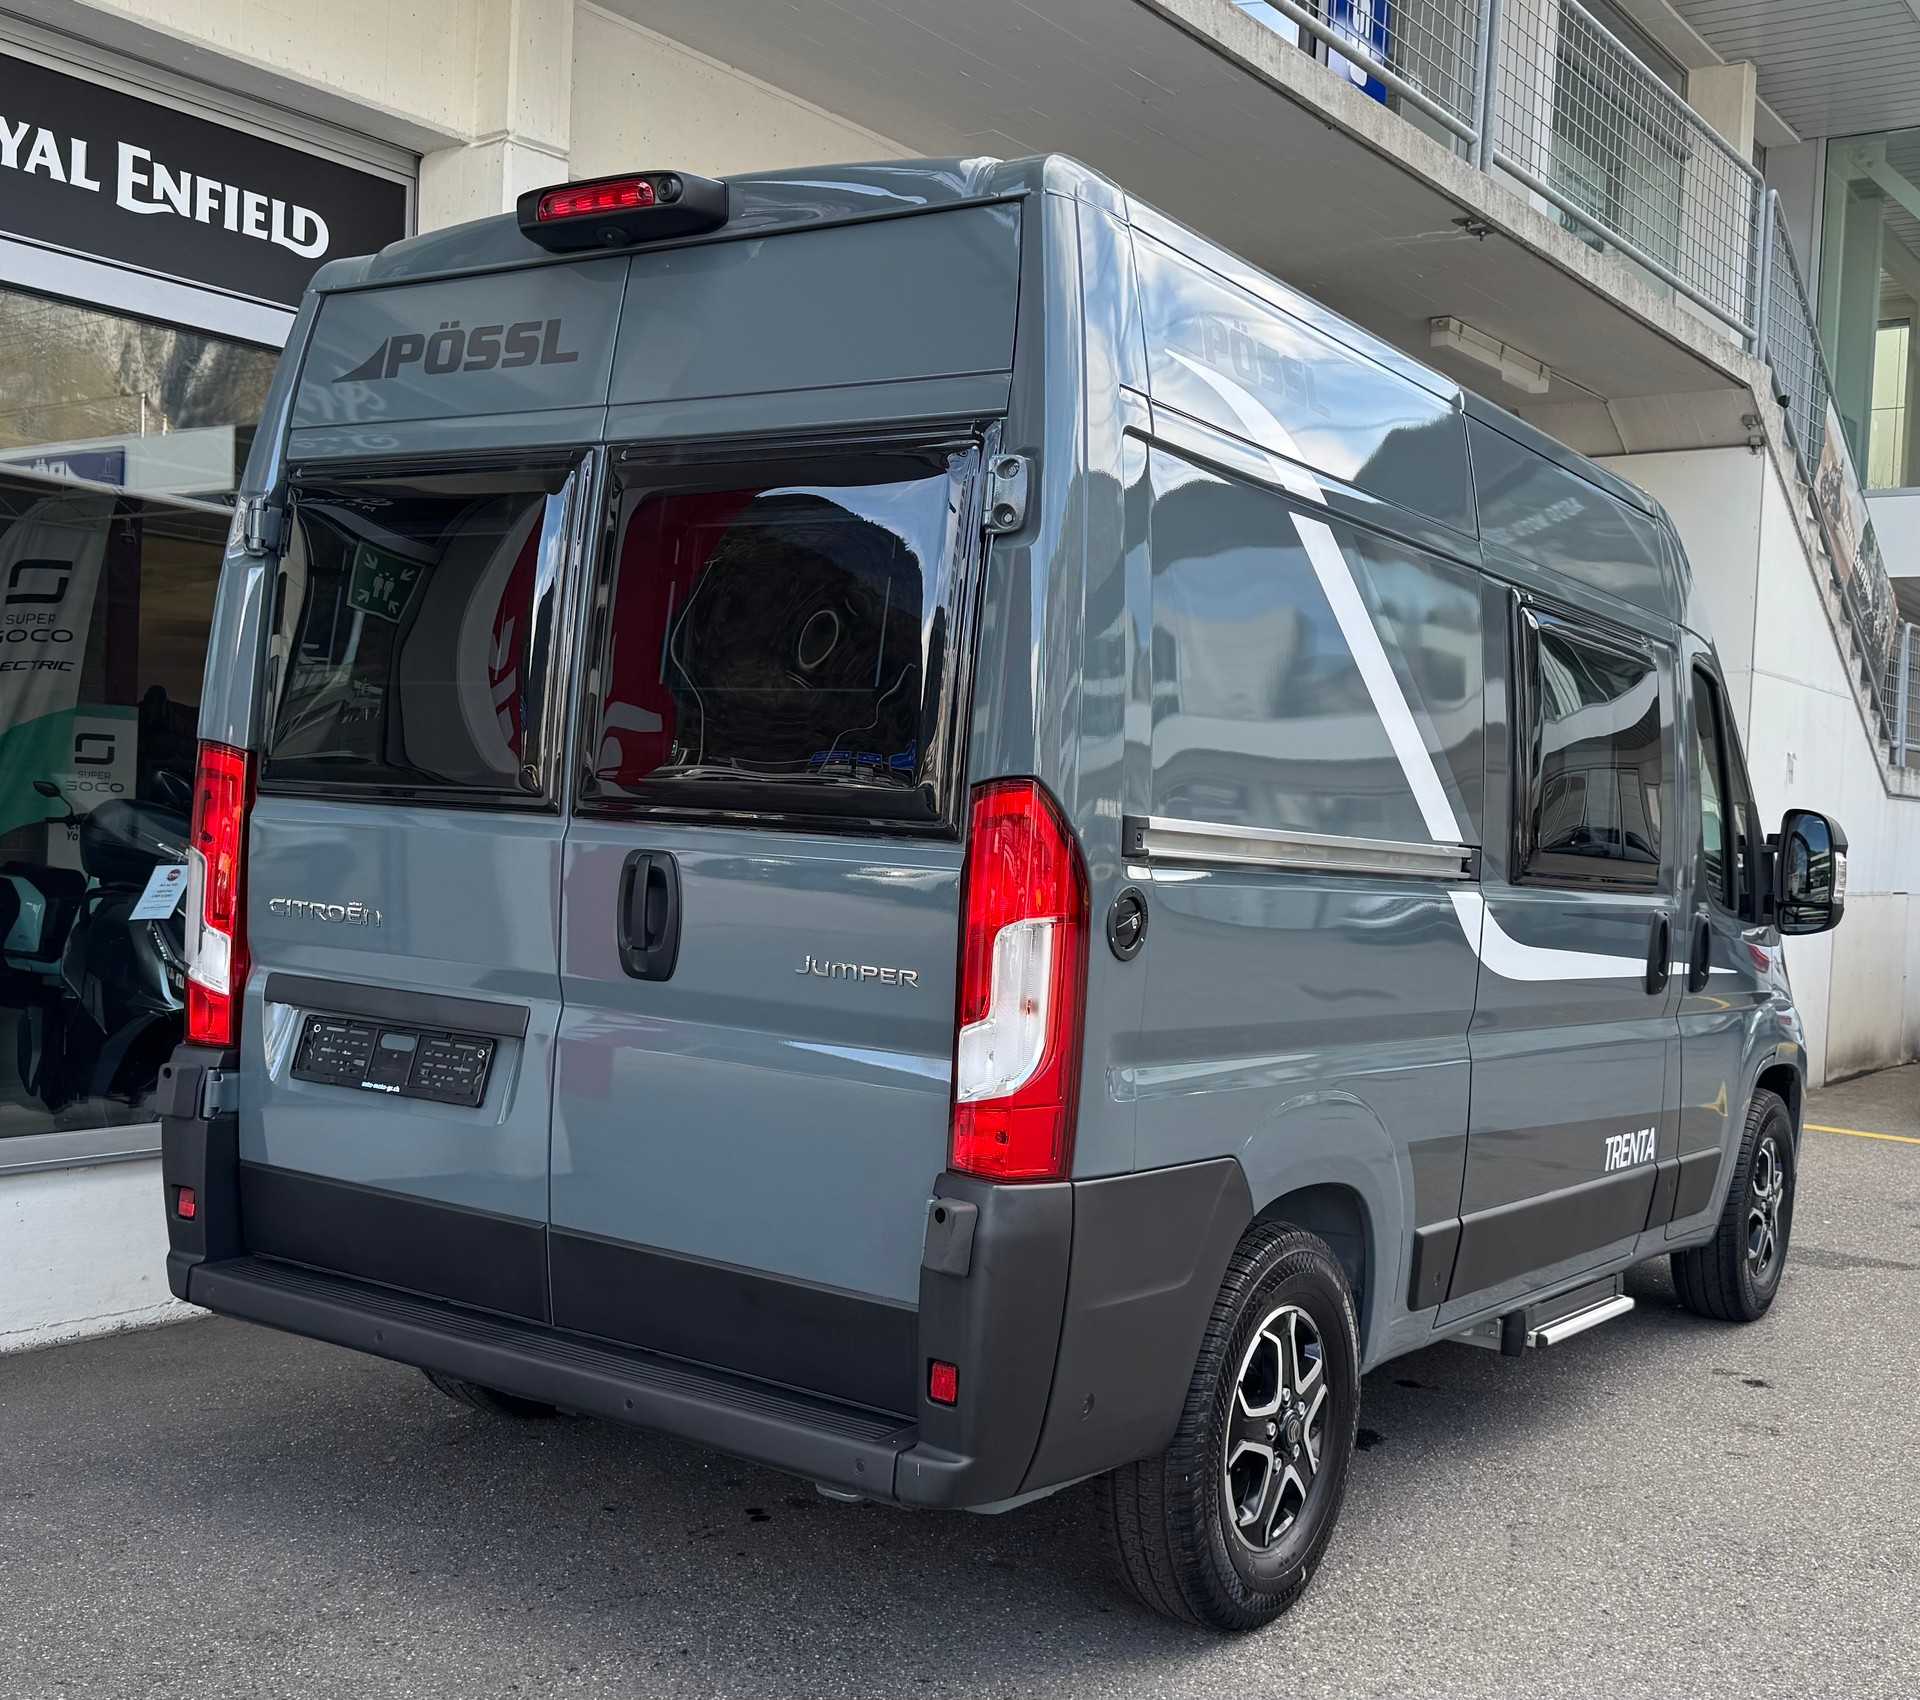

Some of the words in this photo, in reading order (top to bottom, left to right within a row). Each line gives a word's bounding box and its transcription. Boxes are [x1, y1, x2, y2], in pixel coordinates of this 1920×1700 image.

[0, 115, 100, 192] YAL
[116, 141, 330, 259] ENFIELD
[384, 318, 579, 378] PÖSSL
[1201, 314, 1331, 419] PÖSSL
[6, 613, 57, 625] SUPER
[0, 629, 73, 643] OCO
[65, 780, 124, 793] SOCO
[77, 770, 111, 780] SUPER
[1604, 1127, 1655, 1172] TRENTA
